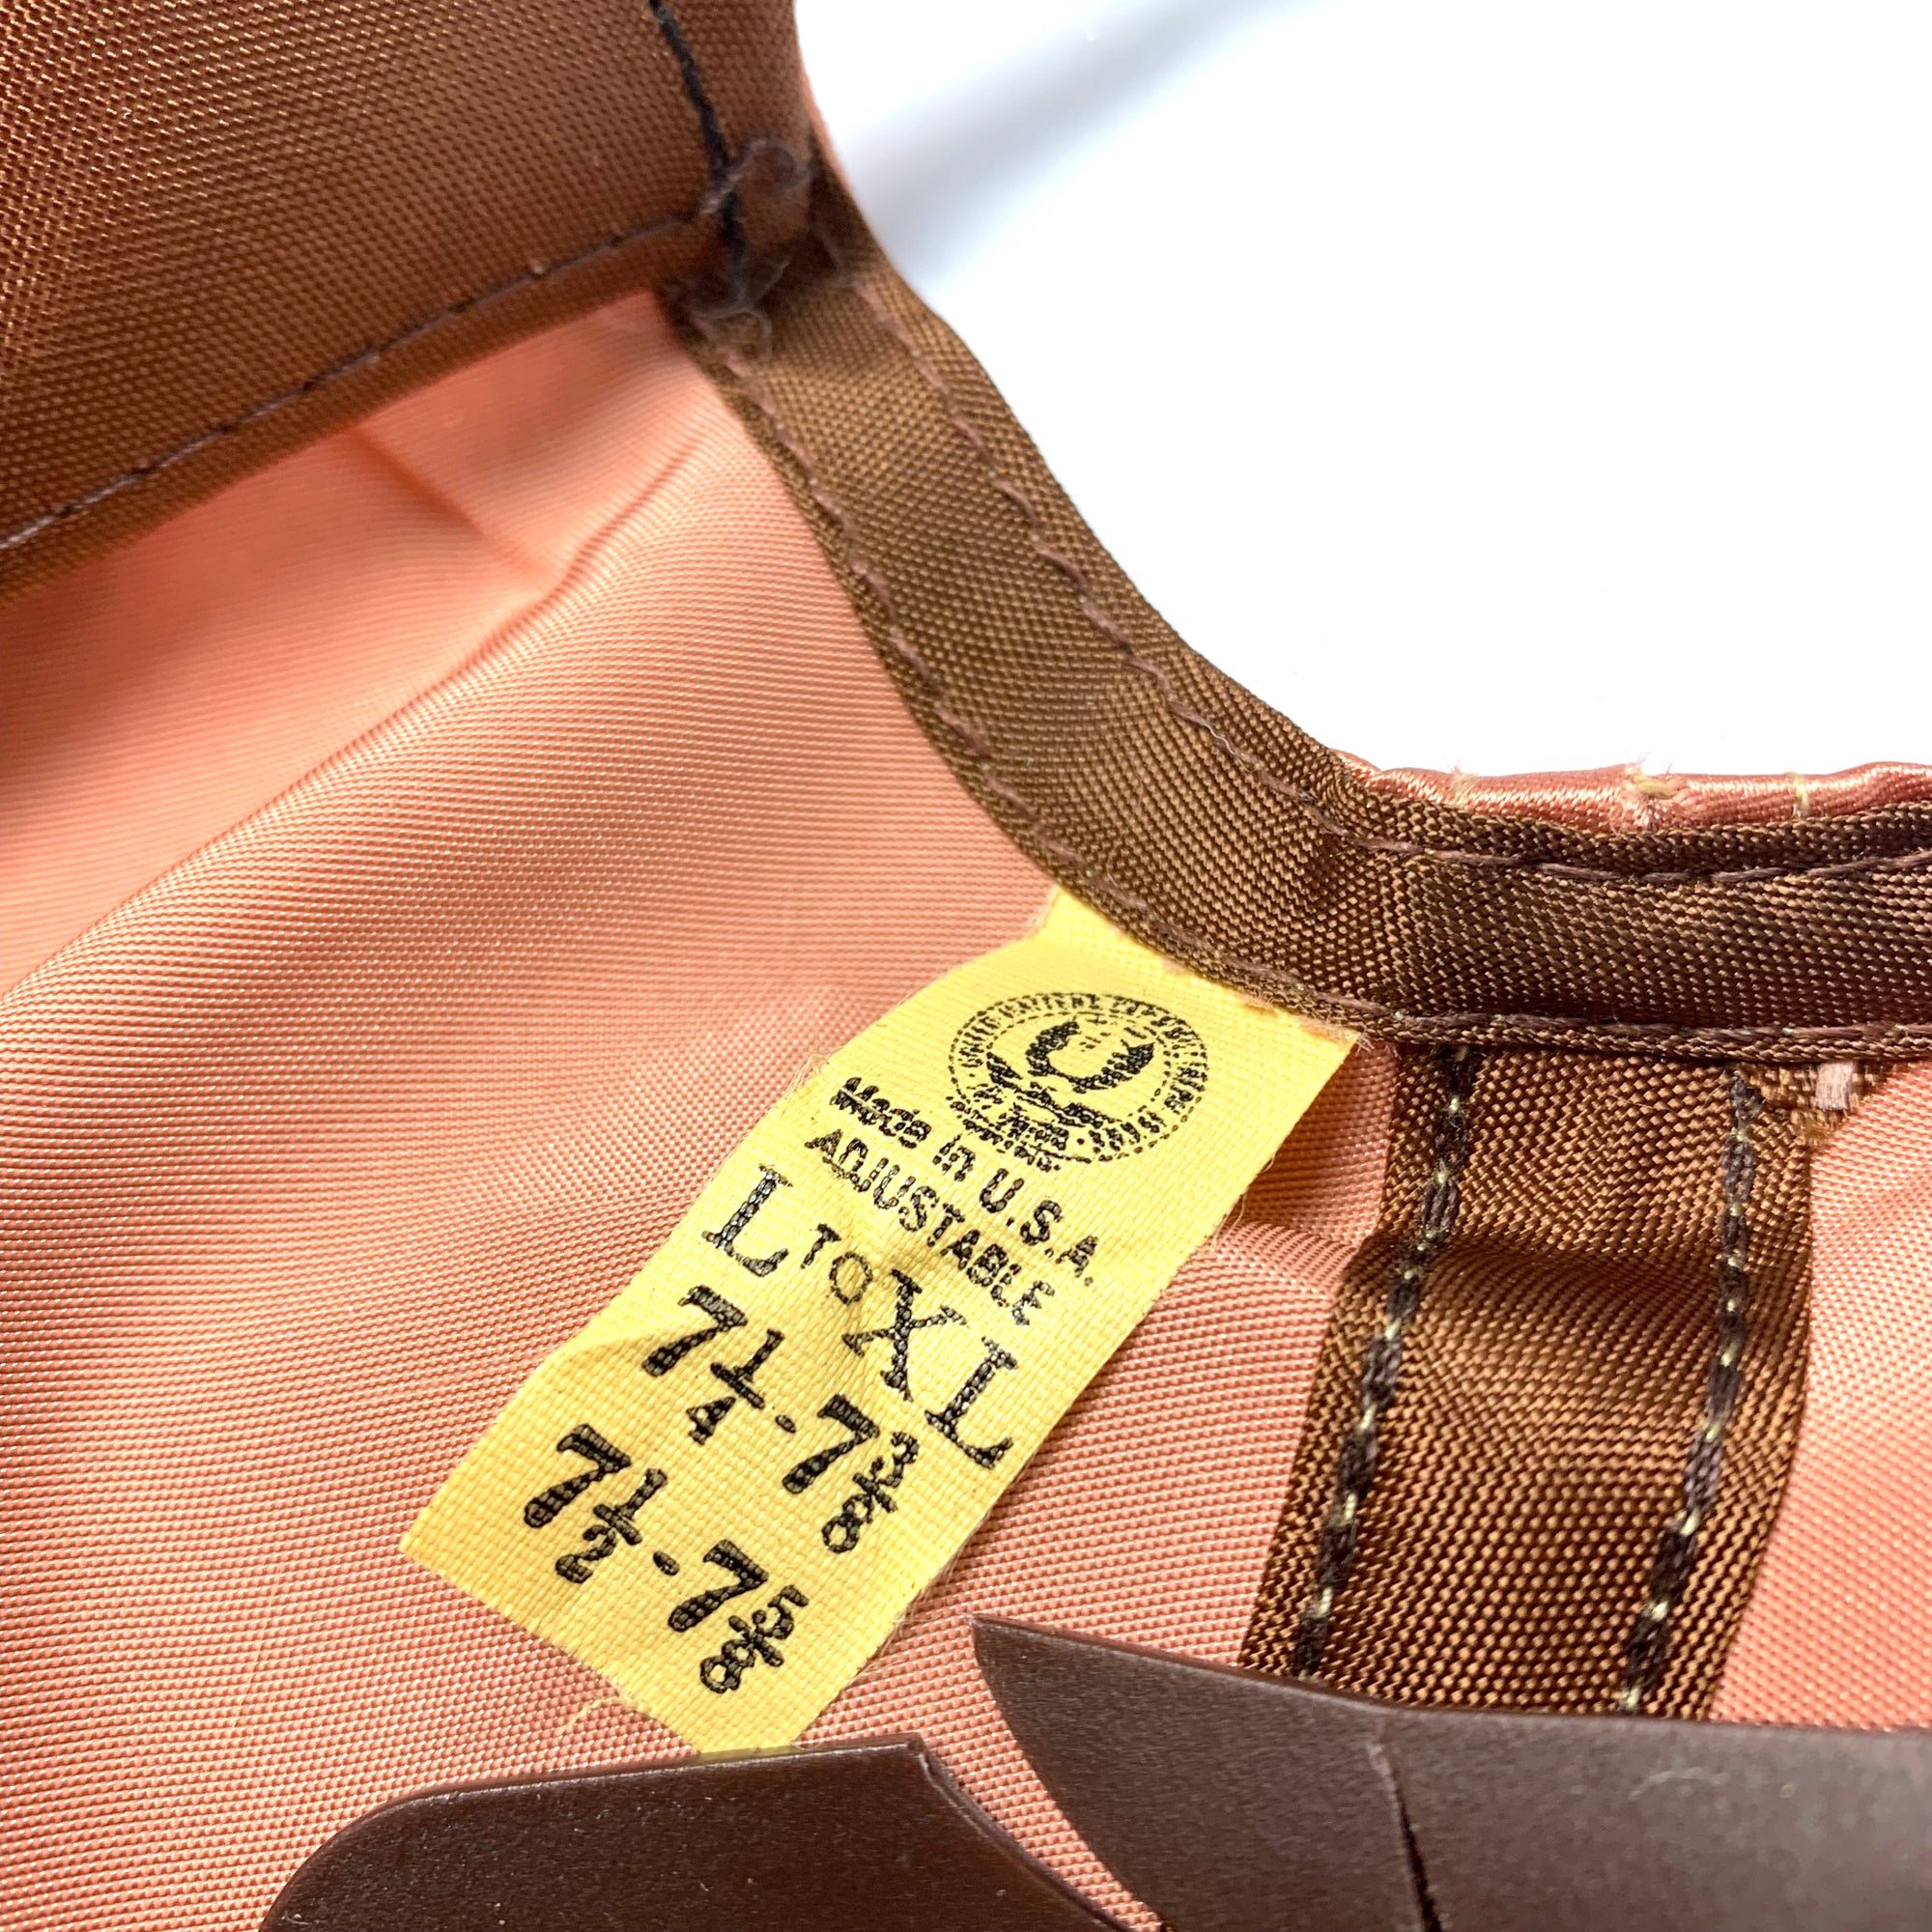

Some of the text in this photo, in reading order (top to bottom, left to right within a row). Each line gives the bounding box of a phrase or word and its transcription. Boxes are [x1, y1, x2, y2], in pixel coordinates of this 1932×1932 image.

[805, 1129, 1055, 1325] ADJUSTABLE
[830, 1077, 931, 1148] Made
[932, 1133, 976, 1181] in
[702, 1164, 1017, 1469] L TO XL
